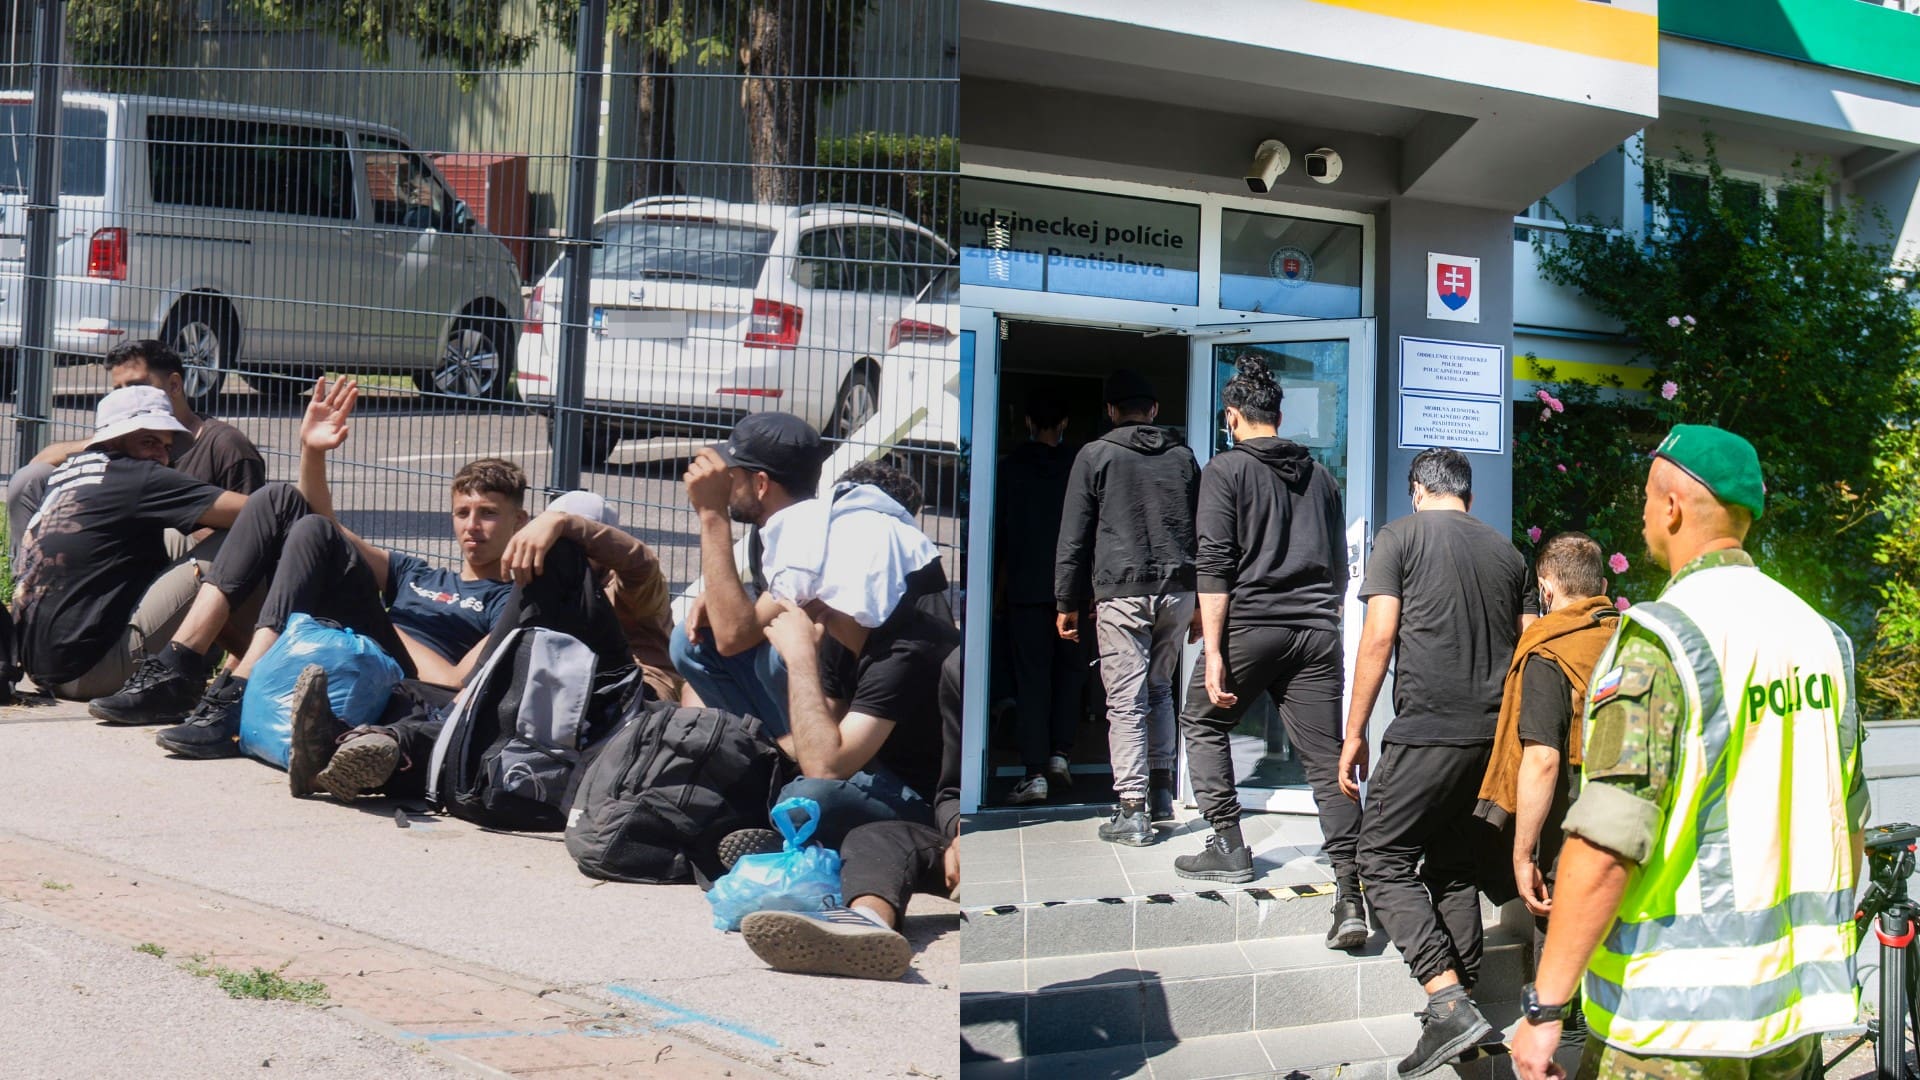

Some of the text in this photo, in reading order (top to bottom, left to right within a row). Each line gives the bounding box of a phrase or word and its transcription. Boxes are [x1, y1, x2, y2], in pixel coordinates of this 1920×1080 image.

[1105, 225, 1184, 249] polície
[965, 240, 1166, 277] zboru Bratislava
[1748, 666, 1833, 722] POLÍCI
